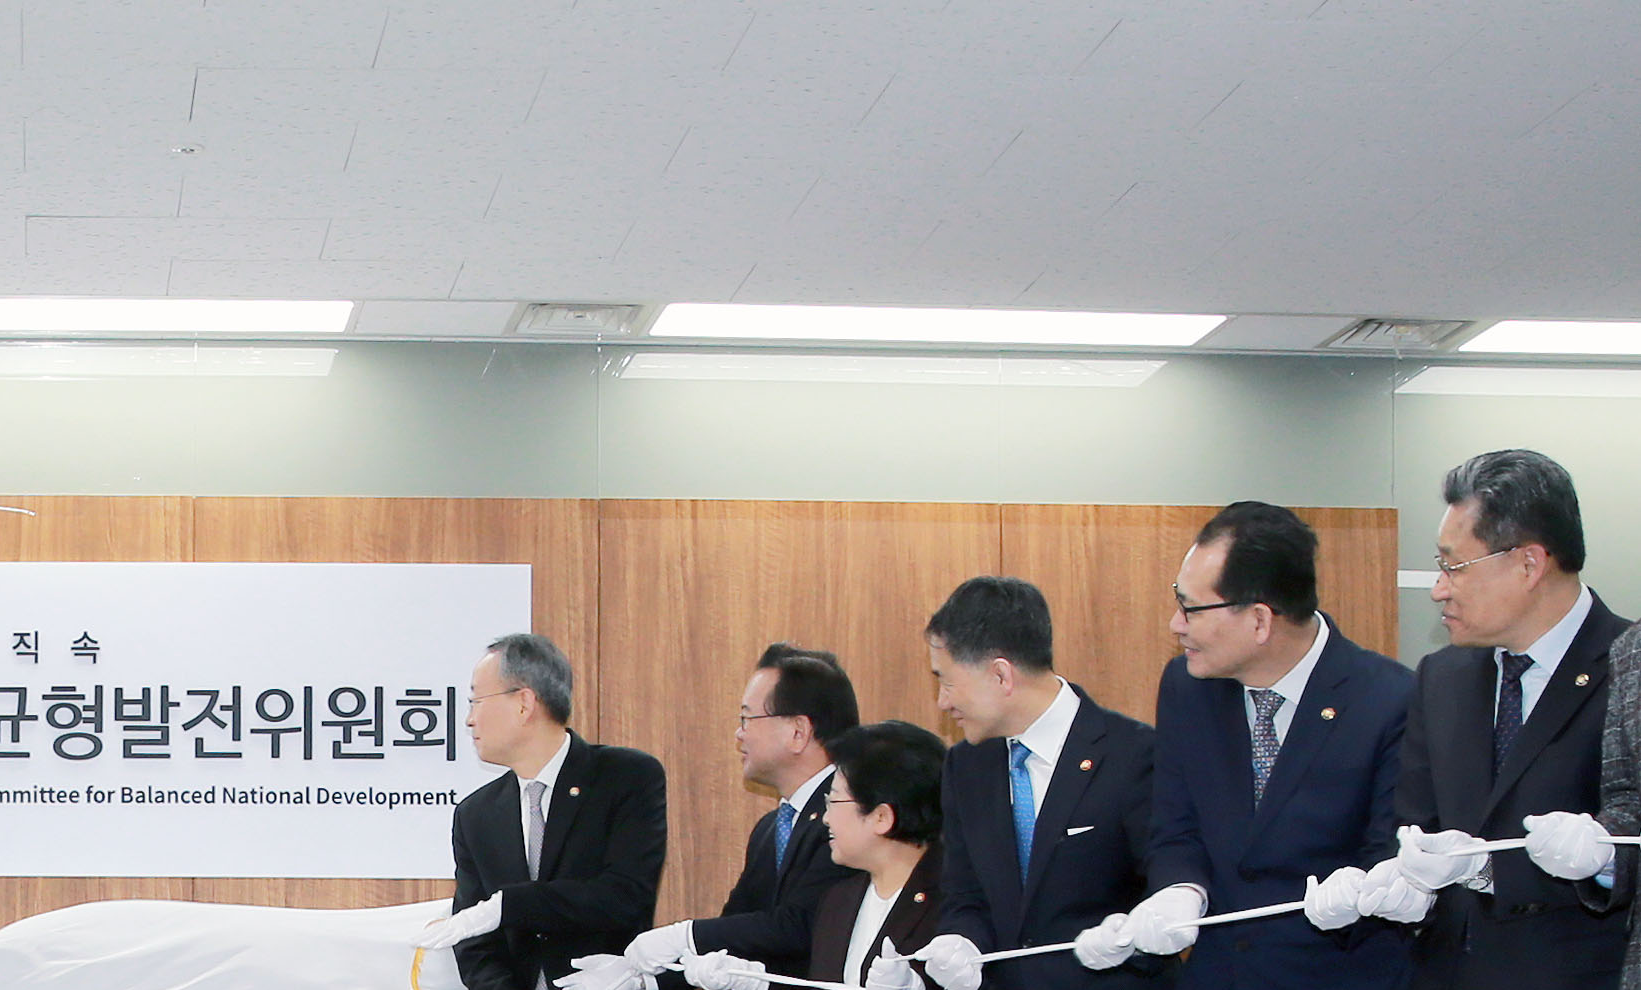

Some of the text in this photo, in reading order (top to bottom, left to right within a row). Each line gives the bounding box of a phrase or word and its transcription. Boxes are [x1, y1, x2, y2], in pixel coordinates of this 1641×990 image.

[86, 785, 116, 804] for
[121, 785, 216, 804] Balanced
[222, 785, 311, 804] National
[317, 786, 457, 810] Development
